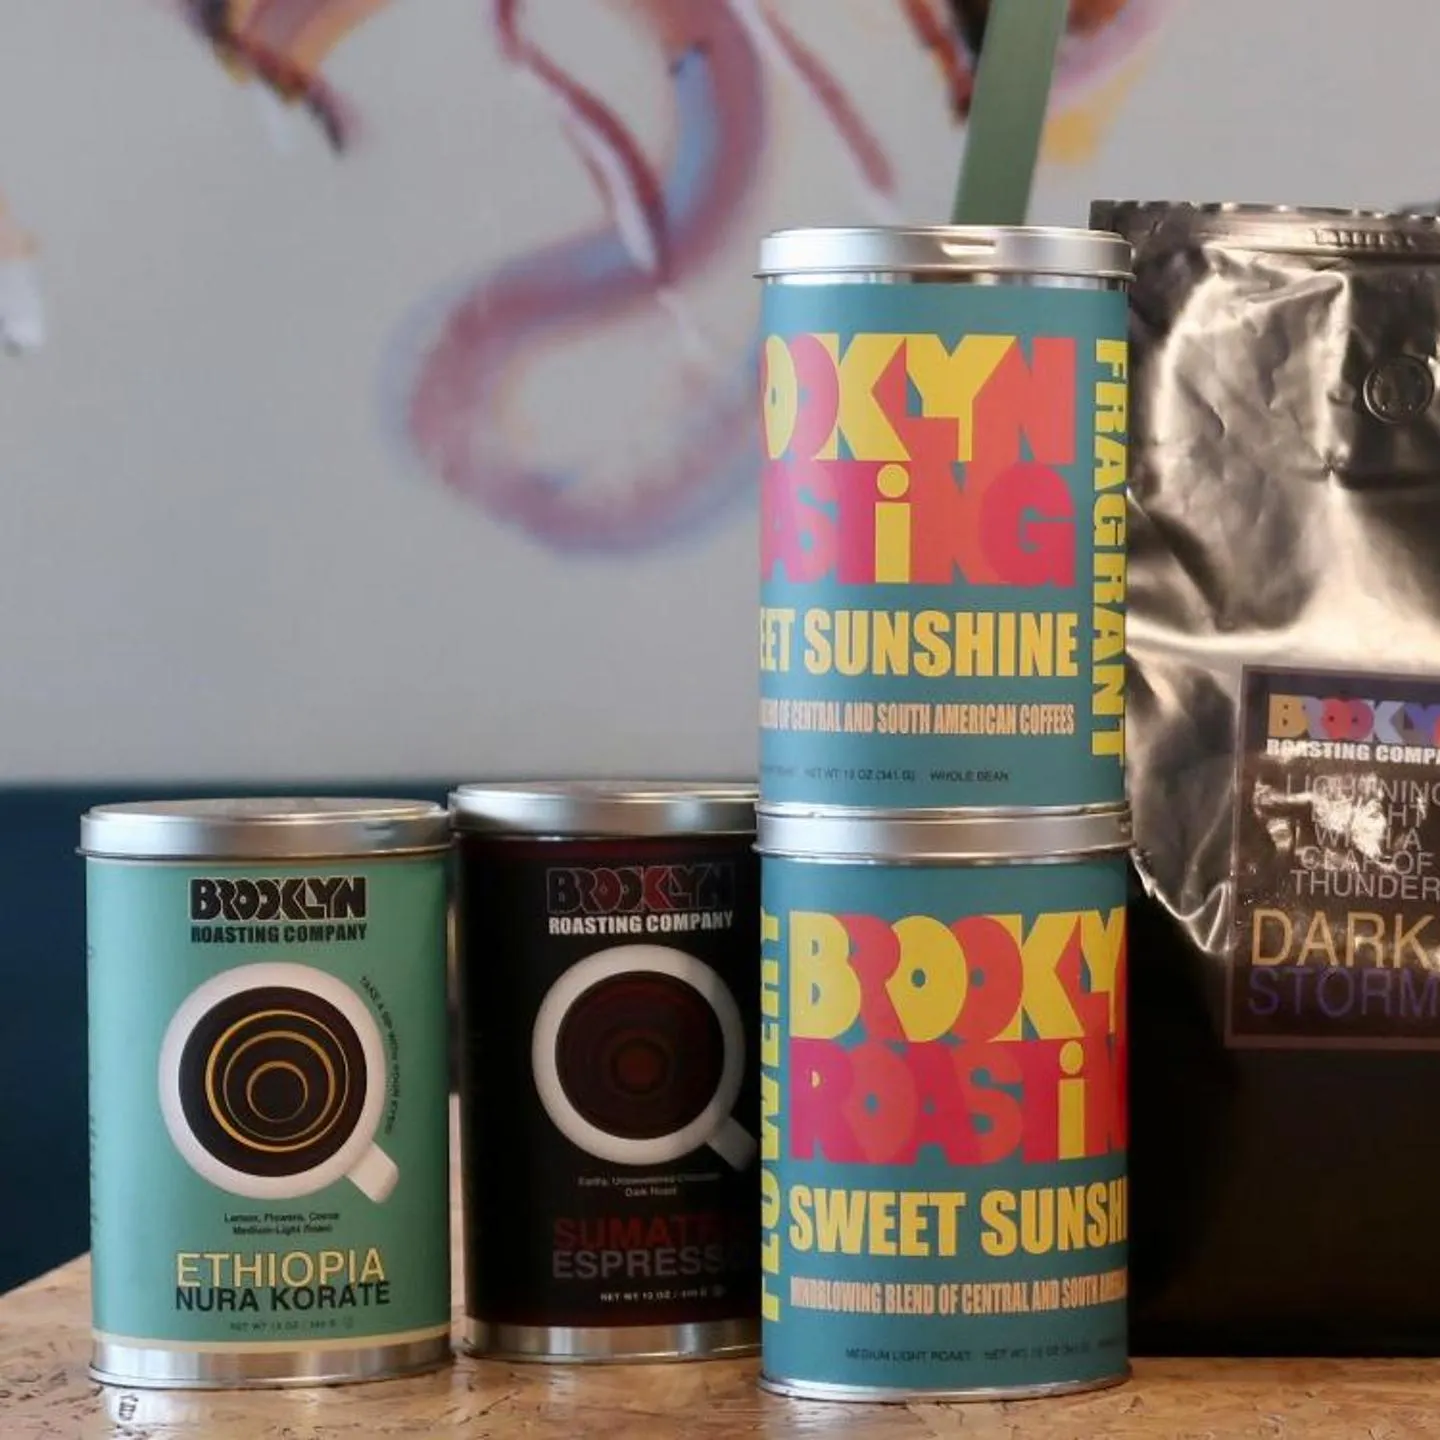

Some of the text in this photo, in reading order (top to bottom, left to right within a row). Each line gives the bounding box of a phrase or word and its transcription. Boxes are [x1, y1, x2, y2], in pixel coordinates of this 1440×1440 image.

[762, 333, 1077, 465] OOKLYN
[1090, 338, 1128, 768] FRAGRANT
[804, 608, 1078, 677] SUNSHINE
[791, 700, 839, 732] CENTRAL
[843, 703, 874, 733] AND
[877, 703, 931, 734] SOUTH
[934, 703, 1017, 735] AMERICAN
[1020, 704, 1075, 735] COFFEES
[1266, 738, 1370, 762] ROASTING
[930, 769, 972, 783] WHOLE
[976, 769, 1009, 783] BEAN
[1402, 827, 1422, 851] A
[1392, 850, 1436, 876] OF
[190, 877, 368, 921] BROOKLYN
[547, 863, 735, 913] BROOKLYN
[1290, 869, 1440, 903] THUNDER
[190, 922, 367, 944] ROASTING COMPANY
[549, 911, 734, 935] ROASTING COMPANY
[789, 907, 1128, 1042] BROOKLY
[788, 1185, 967, 1257] SWEET
[176, 1248, 386, 1288] ETHIOPIA
[552, 1244, 732, 1279] ESPRESS
[176, 1281, 391, 1313] NURA KORATE
[885, 1284, 935, 1314] BLEND
[938, 1285, 960, 1314] OF
[961, 1282, 1030, 1314] CENTRAL
[1032, 1279, 1060, 1312] AND
[1061, 1274, 1098, 1308] SOUTH
